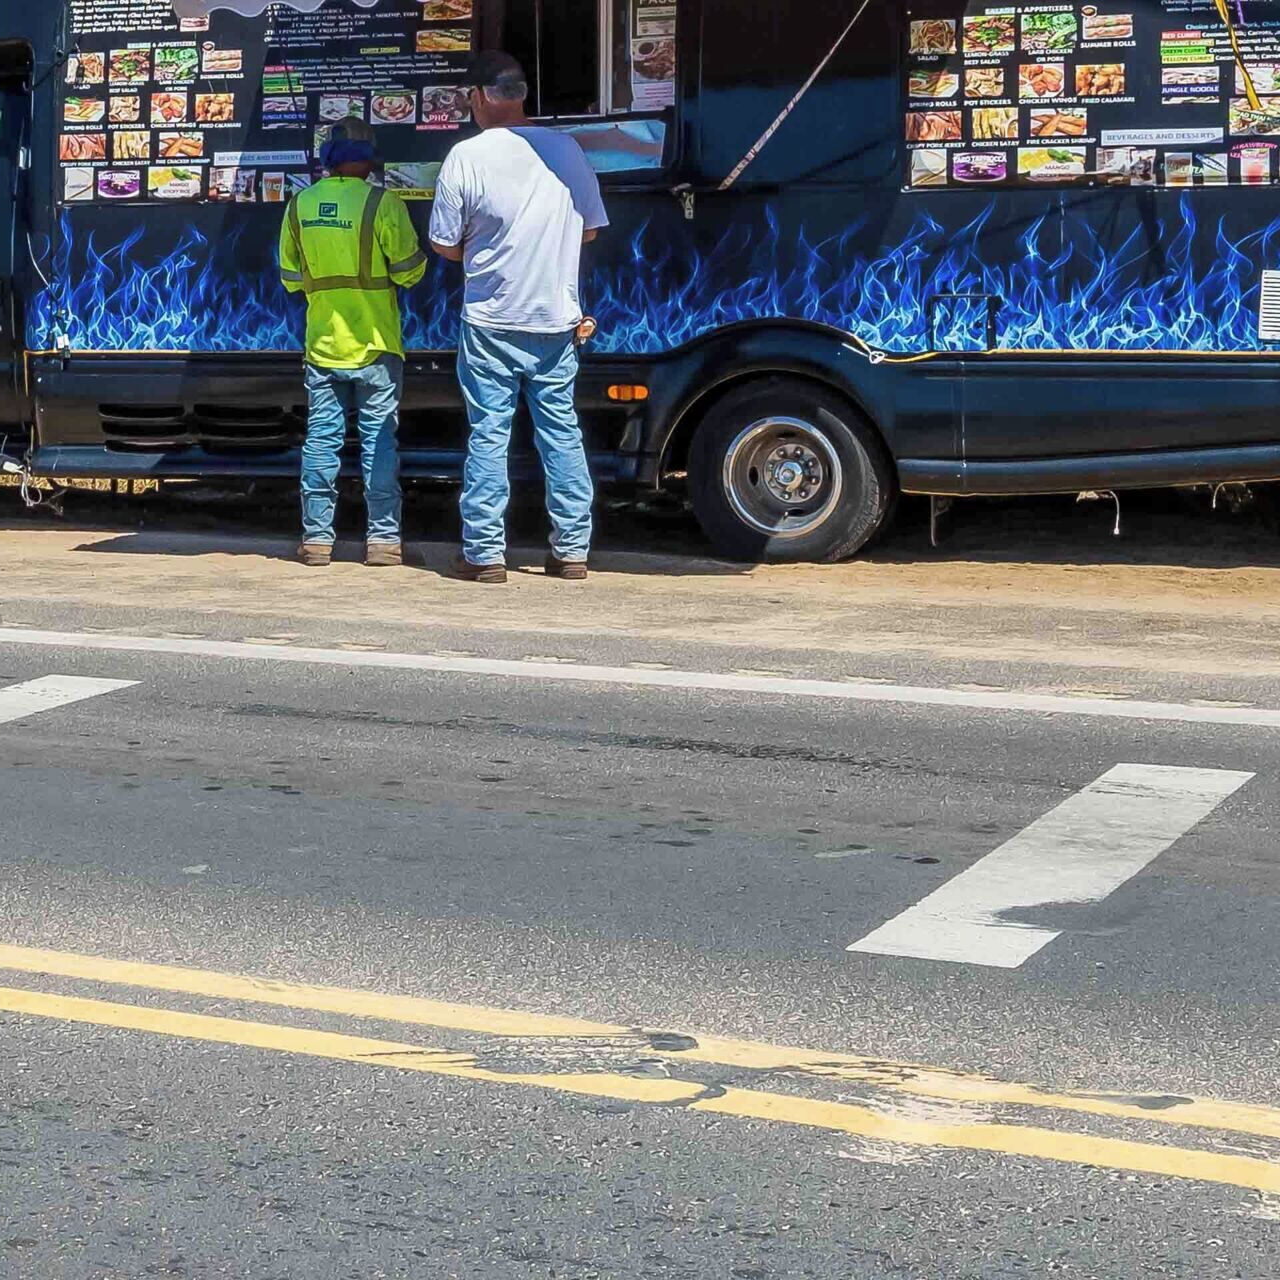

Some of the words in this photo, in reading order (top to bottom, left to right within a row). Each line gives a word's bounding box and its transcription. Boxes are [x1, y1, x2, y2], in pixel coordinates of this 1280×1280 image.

[1080, 41, 1111, 49] SUMMER
[1046, 47, 1073, 55] CHICKEN
[1162, 86, 1189, 94] JUNGLE
[1190, 85, 1219, 93] NOODLE
[1051, 96, 1078, 104] WINGS
[1101, 96, 1135, 104] CALAMARI
[1107, 133, 1154, 141] BEVERAGES
